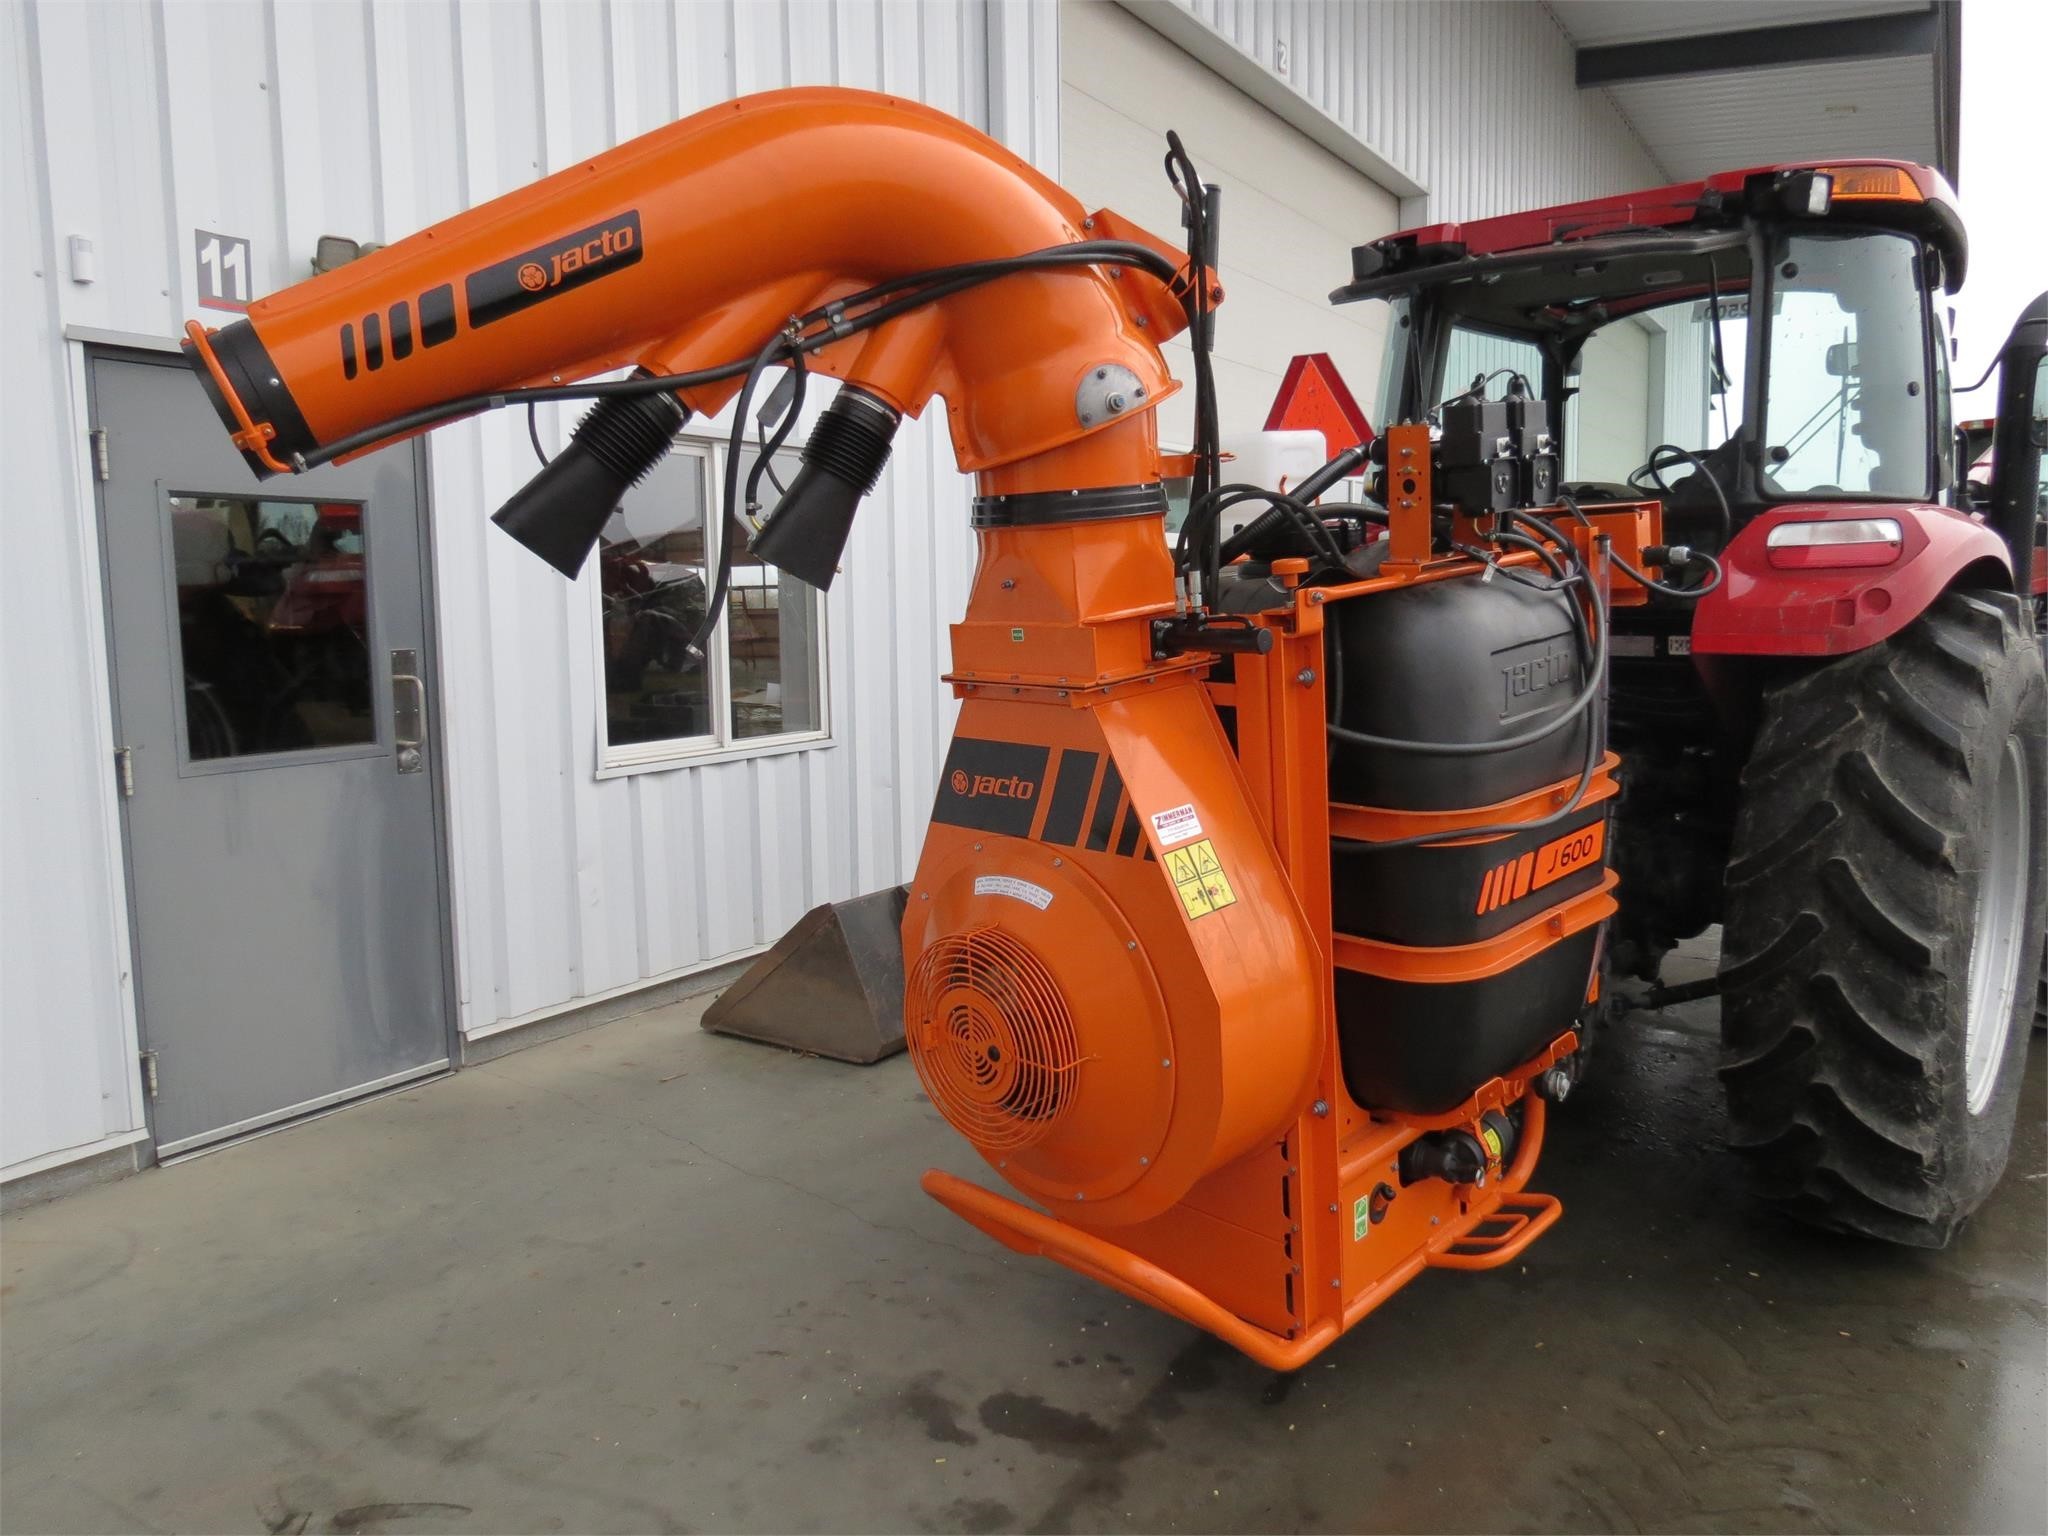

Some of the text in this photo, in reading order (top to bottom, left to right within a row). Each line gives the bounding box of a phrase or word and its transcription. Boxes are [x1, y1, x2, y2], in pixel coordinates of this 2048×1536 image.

[201, 238, 247, 301] 11
[550, 226, 633, 287] jacto
[968, 775, 1034, 800] jacto
[1547, 834, 1594, 874] J 600
